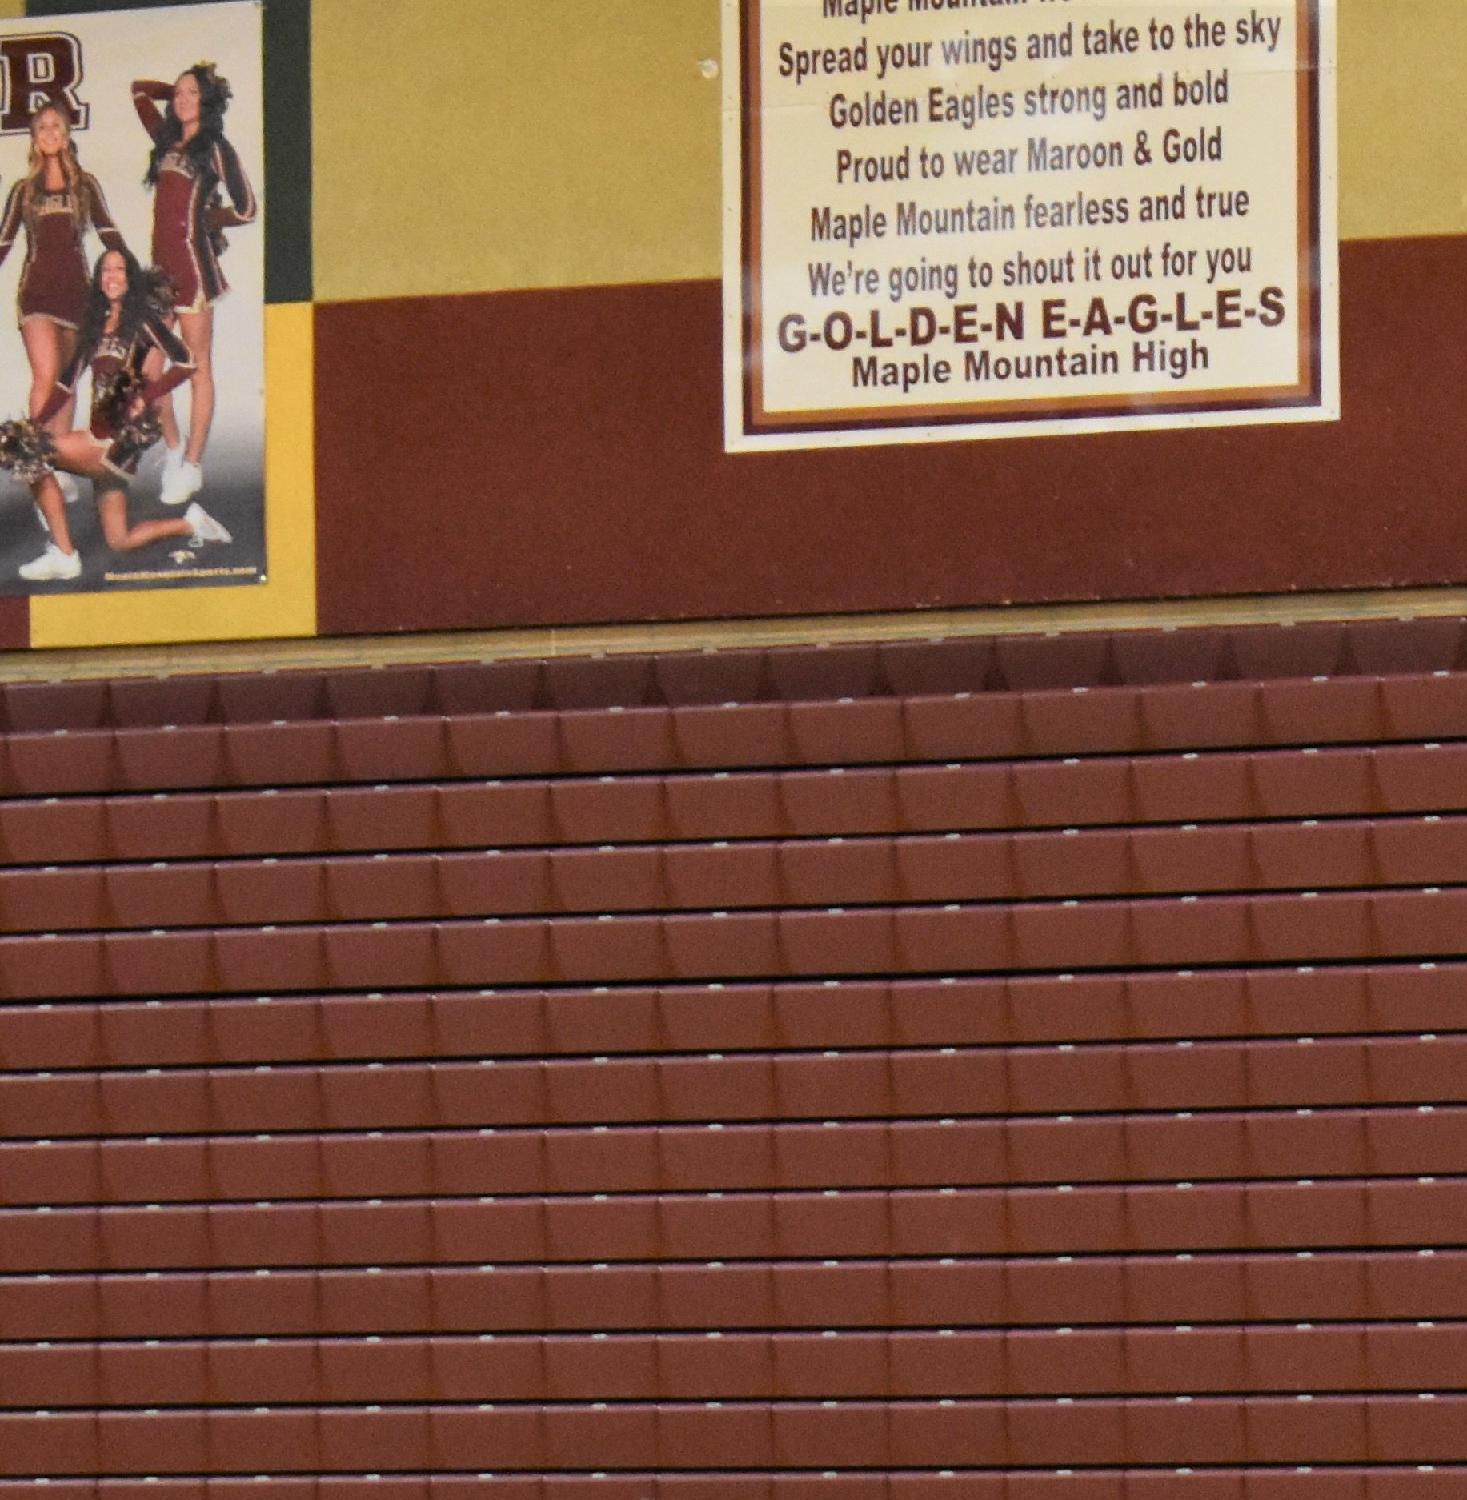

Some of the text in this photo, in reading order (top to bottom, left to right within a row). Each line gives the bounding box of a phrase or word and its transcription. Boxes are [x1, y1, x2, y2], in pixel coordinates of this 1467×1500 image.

[779, 9, 1281, 85] Spread your wings and take to the sky
[829, 68, 1229, 130] Golden Eagles strong and bold
[837, 126, 1222, 184] Proud to wear Maroon & Gold
[811, 185, 1249, 248] Maple Mountain fearless and true
[808, 242, 1252, 303] We're going to shout it out for you
[777, 286, 1285, 354] G-O-L-D-E-N E-A-G-L-E-S
[852, 338, 1208, 394] Maple Mountain High
